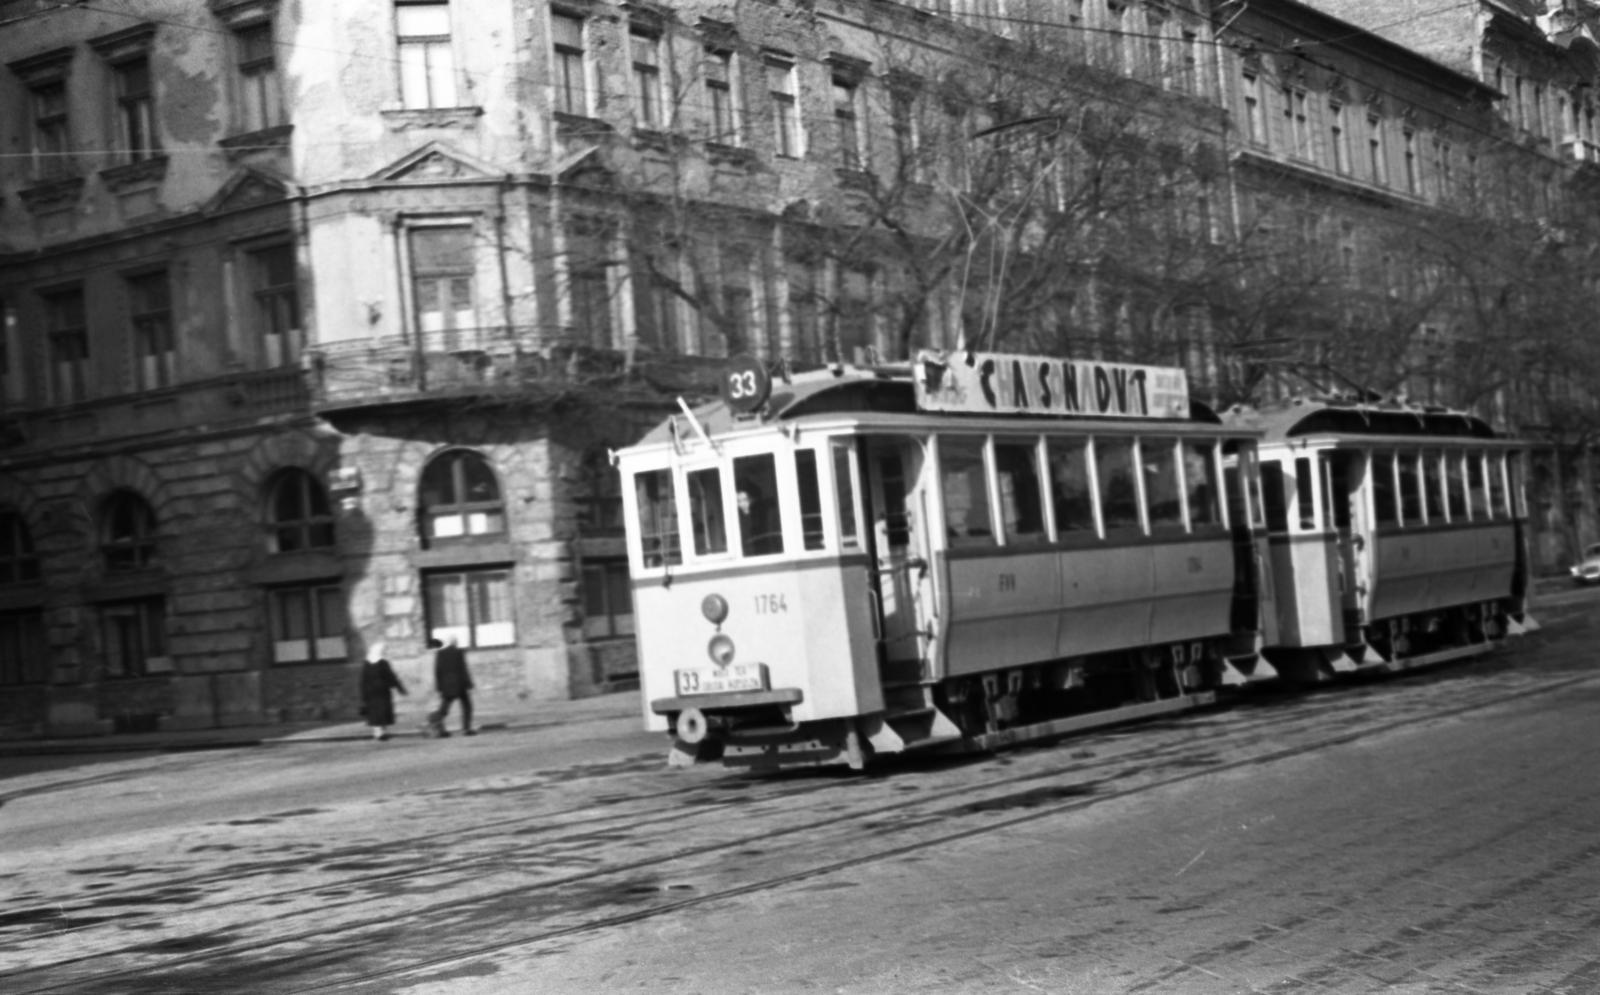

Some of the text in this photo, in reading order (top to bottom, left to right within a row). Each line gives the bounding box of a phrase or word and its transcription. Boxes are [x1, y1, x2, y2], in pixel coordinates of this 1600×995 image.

[730, 370, 756, 398] 33
[754, 593, 788, 614] 1764
[682, 671, 699, 691] 33
